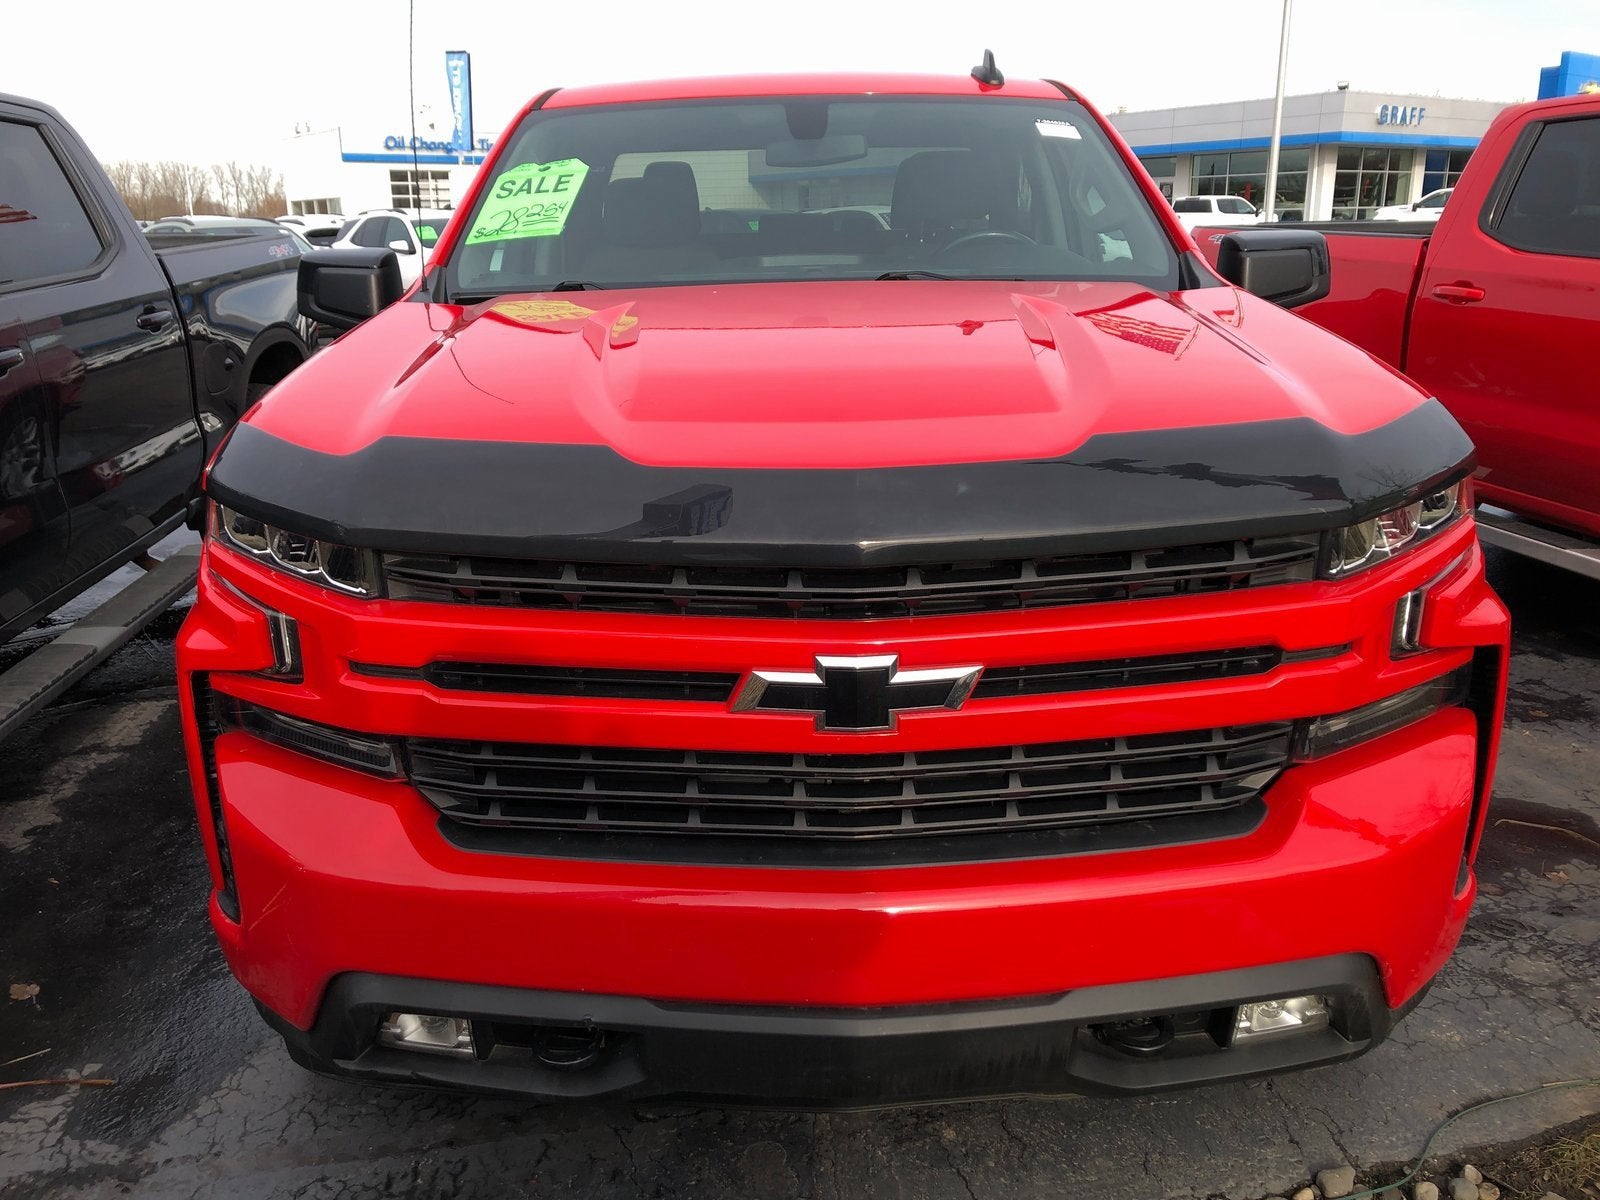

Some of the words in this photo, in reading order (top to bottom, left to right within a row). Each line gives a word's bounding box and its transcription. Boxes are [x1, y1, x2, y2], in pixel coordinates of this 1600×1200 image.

[1377, 104, 1426, 126] GRAFF
[384, 135, 405, 151] Oil
[409, 136, 457, 154] Chang
[495, 174, 575, 199] SALE
